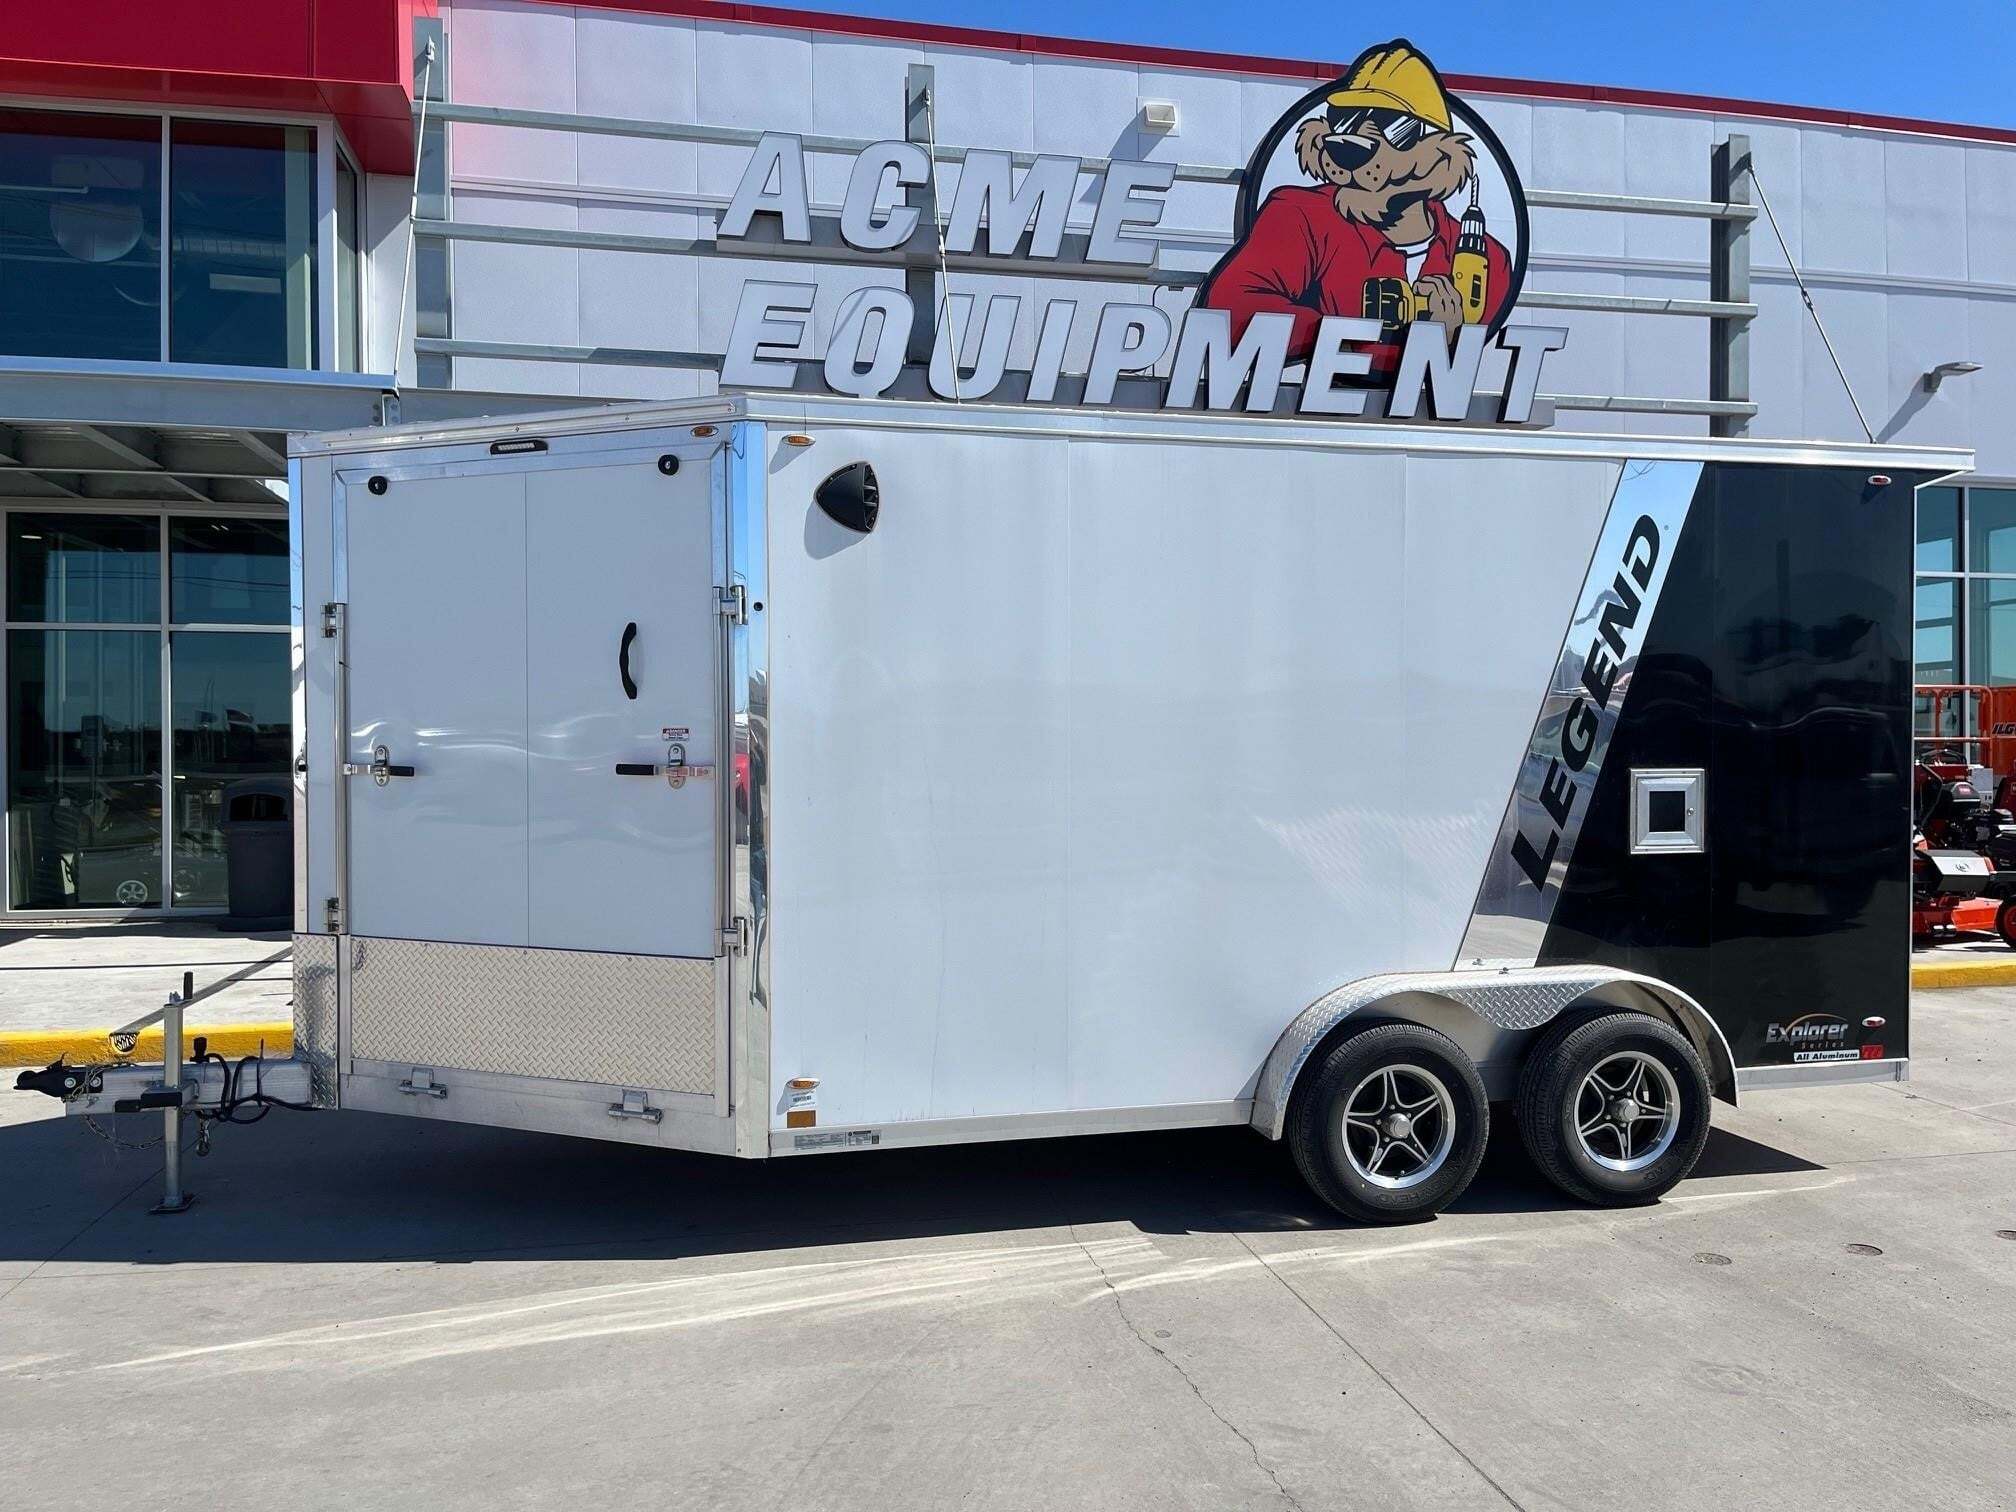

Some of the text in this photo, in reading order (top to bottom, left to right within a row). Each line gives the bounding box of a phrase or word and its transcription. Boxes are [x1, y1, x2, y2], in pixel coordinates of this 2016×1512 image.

[717, 131, 1177, 265] ACME
[719, 279, 1569, 423] EQUIPMENT
[1511, 514, 1660, 893] LEGEND
[1766, 1022, 1848, 1046] Explorer
[1797, 1051, 1858, 1061] All Aluminum
